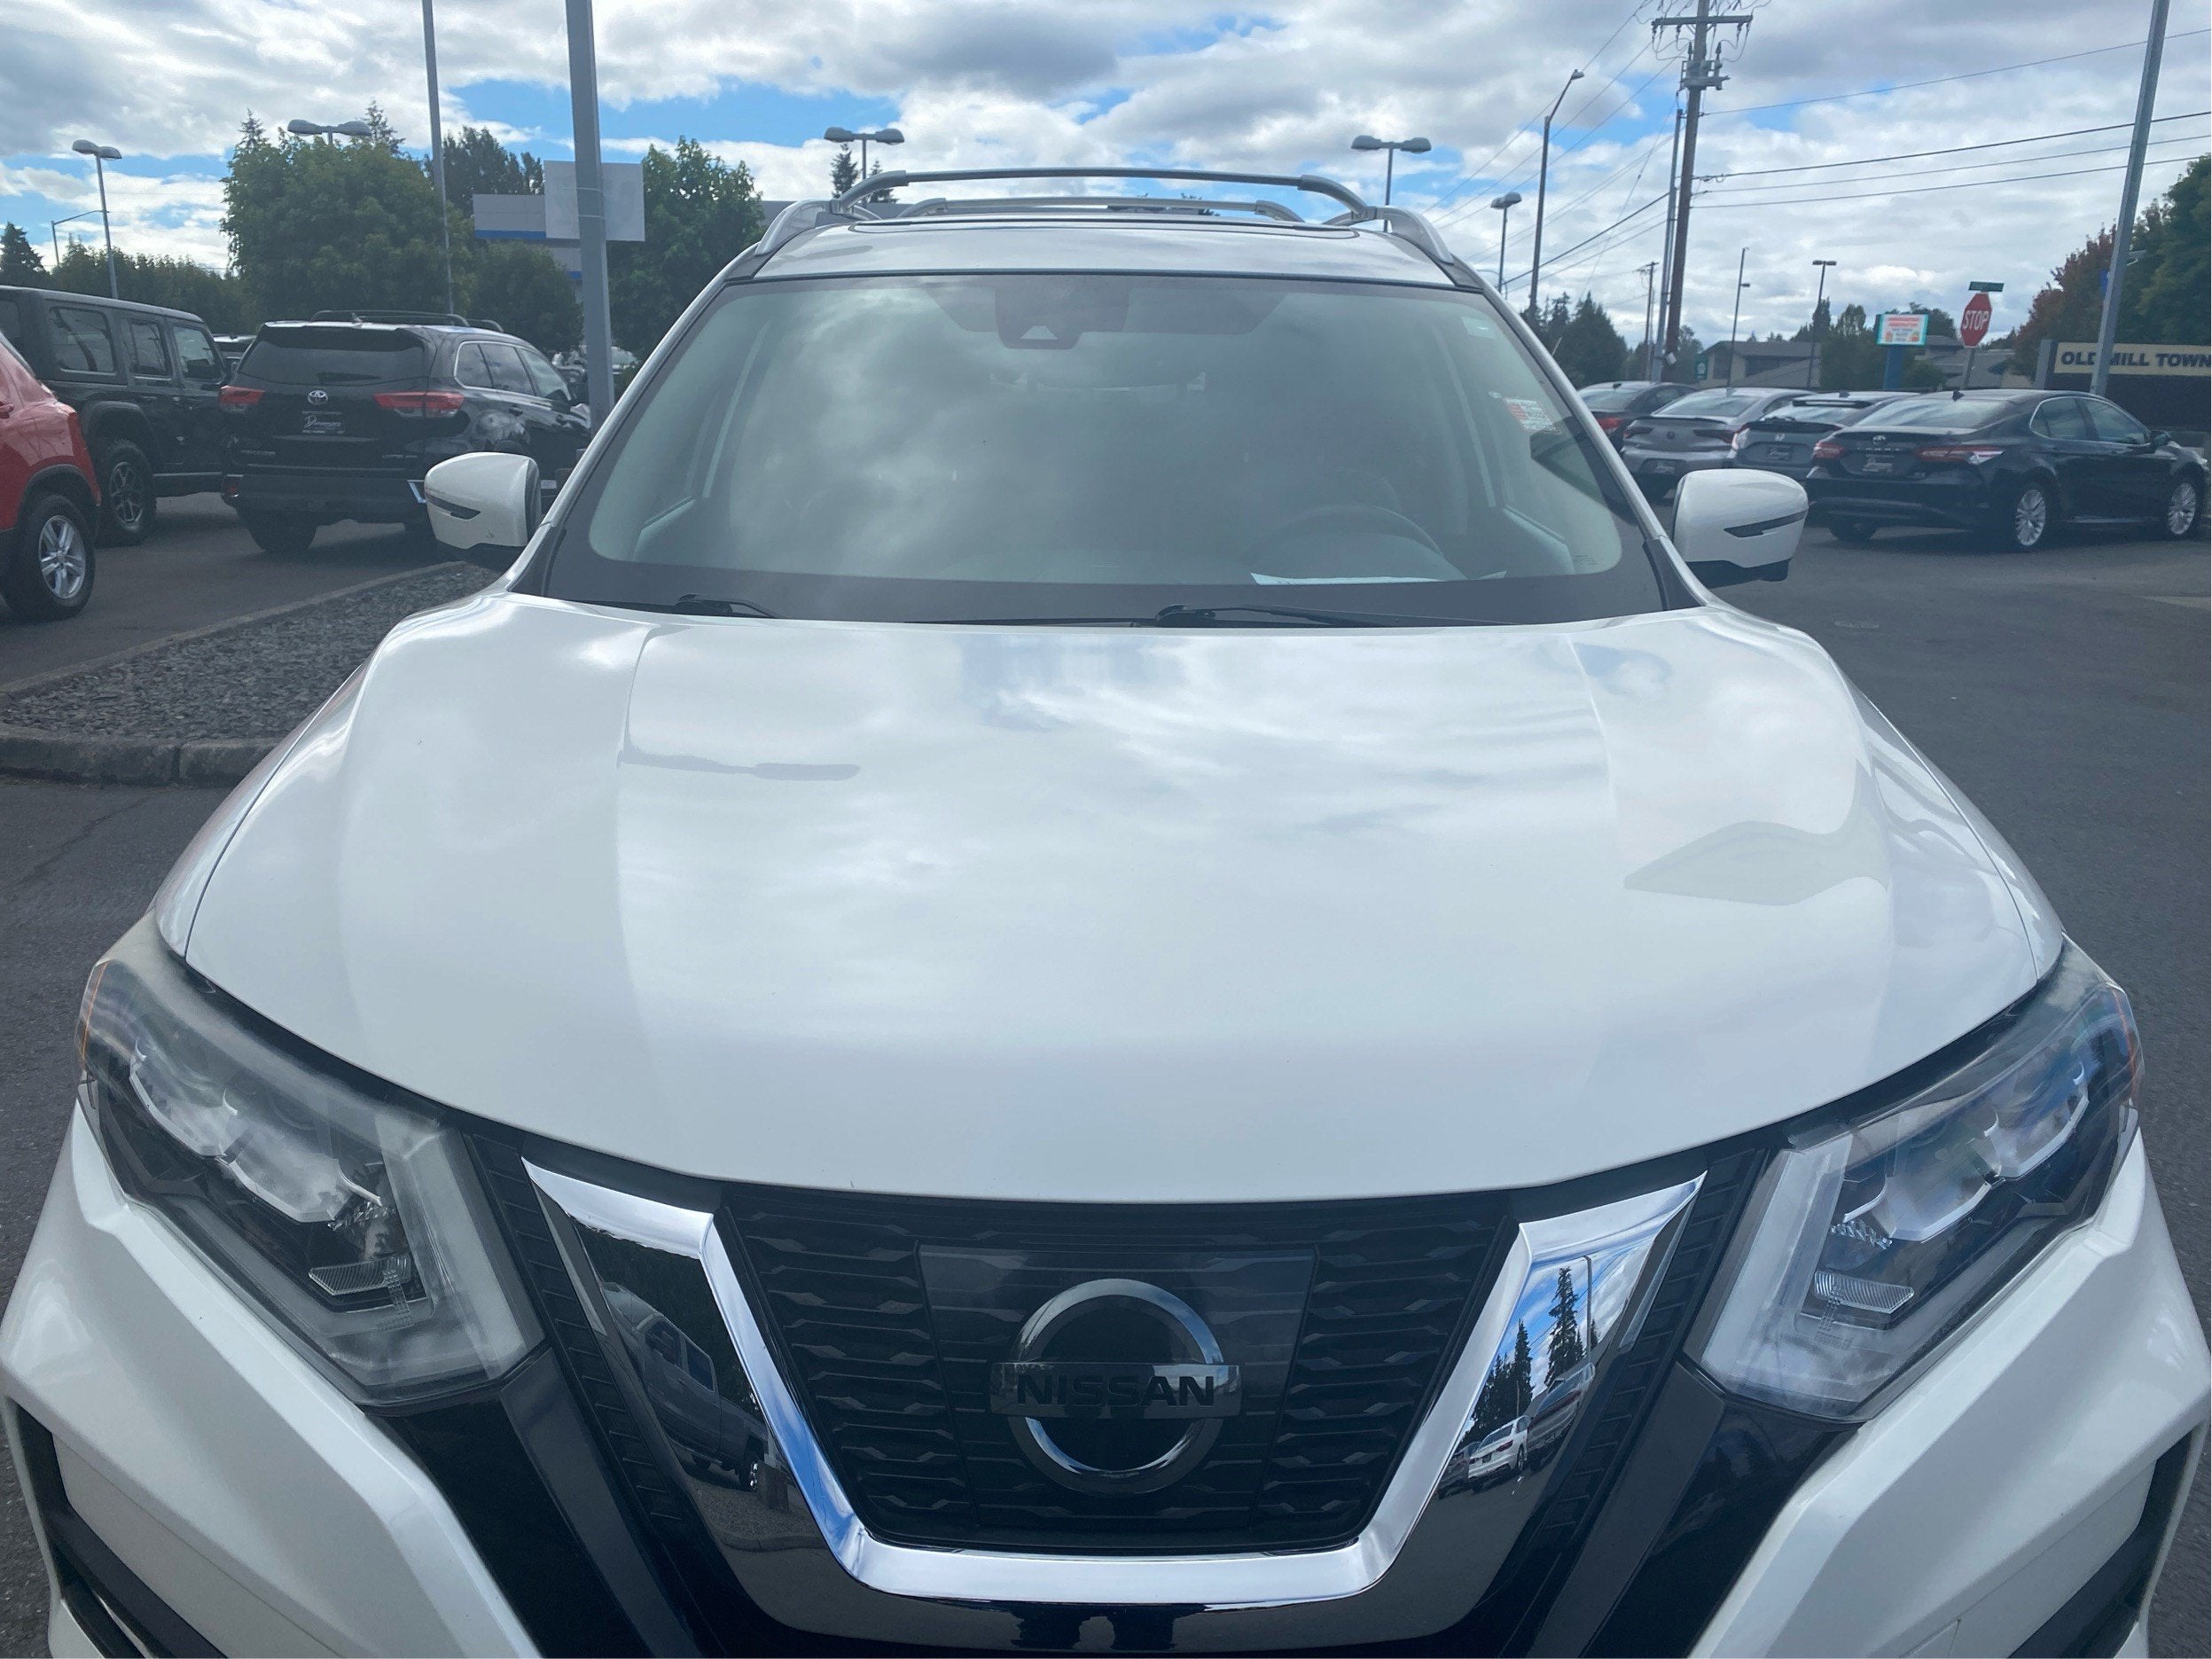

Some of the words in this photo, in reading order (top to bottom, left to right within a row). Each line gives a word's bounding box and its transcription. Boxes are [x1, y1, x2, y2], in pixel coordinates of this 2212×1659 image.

[1962, 310, 1989, 330] STOP
[2061, 351, 2097, 365] OLD
[2155, 353, 2210, 368] TOWN
[1017, 1374, 1215, 1407] NISSAN
